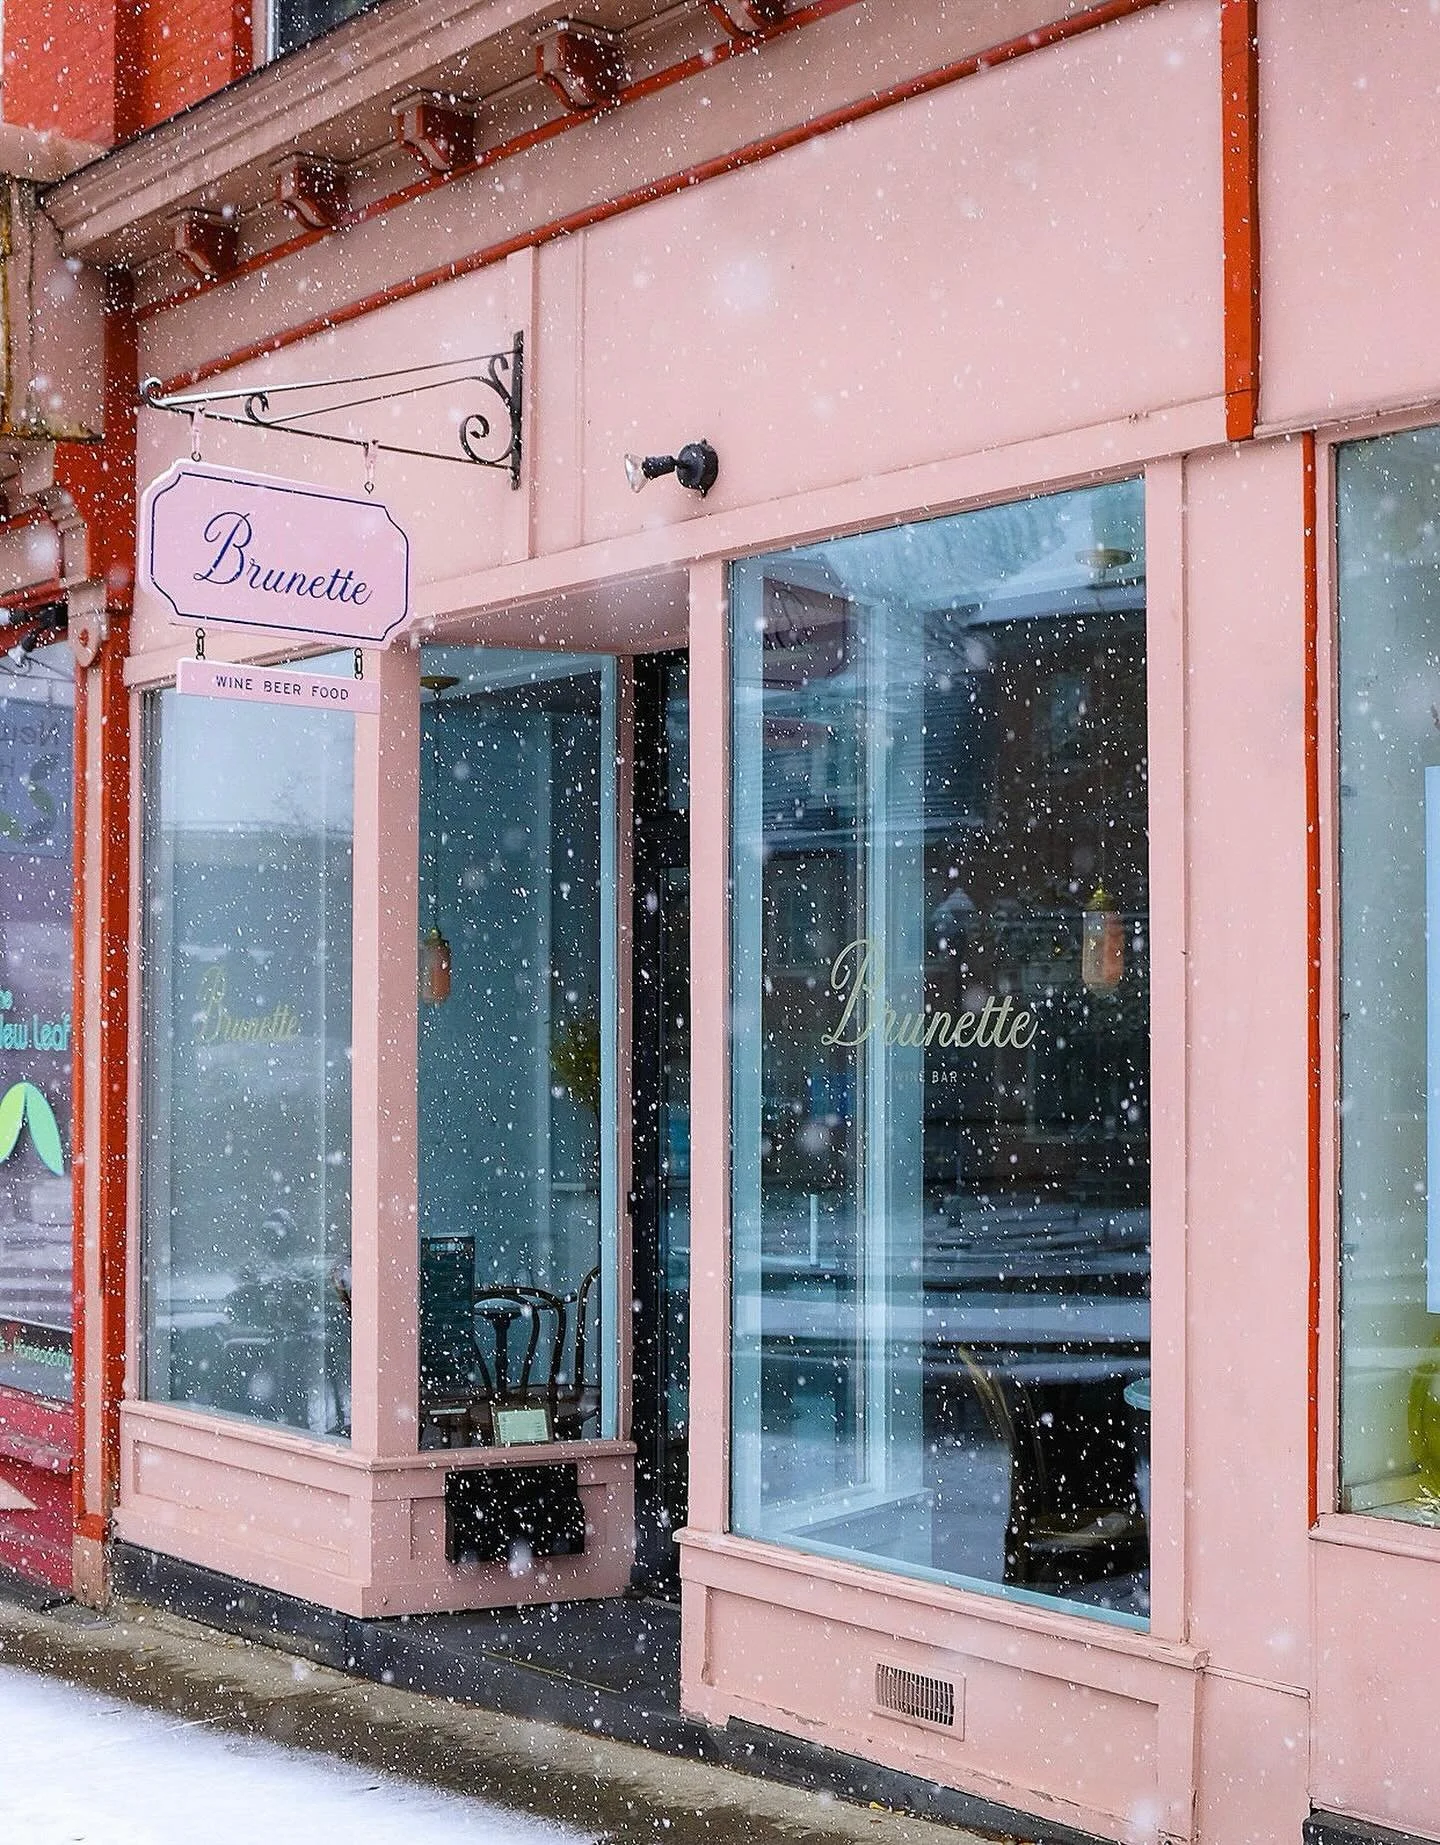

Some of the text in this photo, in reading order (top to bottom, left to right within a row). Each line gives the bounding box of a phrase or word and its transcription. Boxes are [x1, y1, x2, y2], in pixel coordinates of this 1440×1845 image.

[193, 511, 373, 605] Brunette
[216, 675, 349, 700] WINE BEER FOOD
[195, 966, 300, 1047] Brunette
[821, 939, 1039, 1049] Brunette
[931, 1071, 957, 1084] BAR
